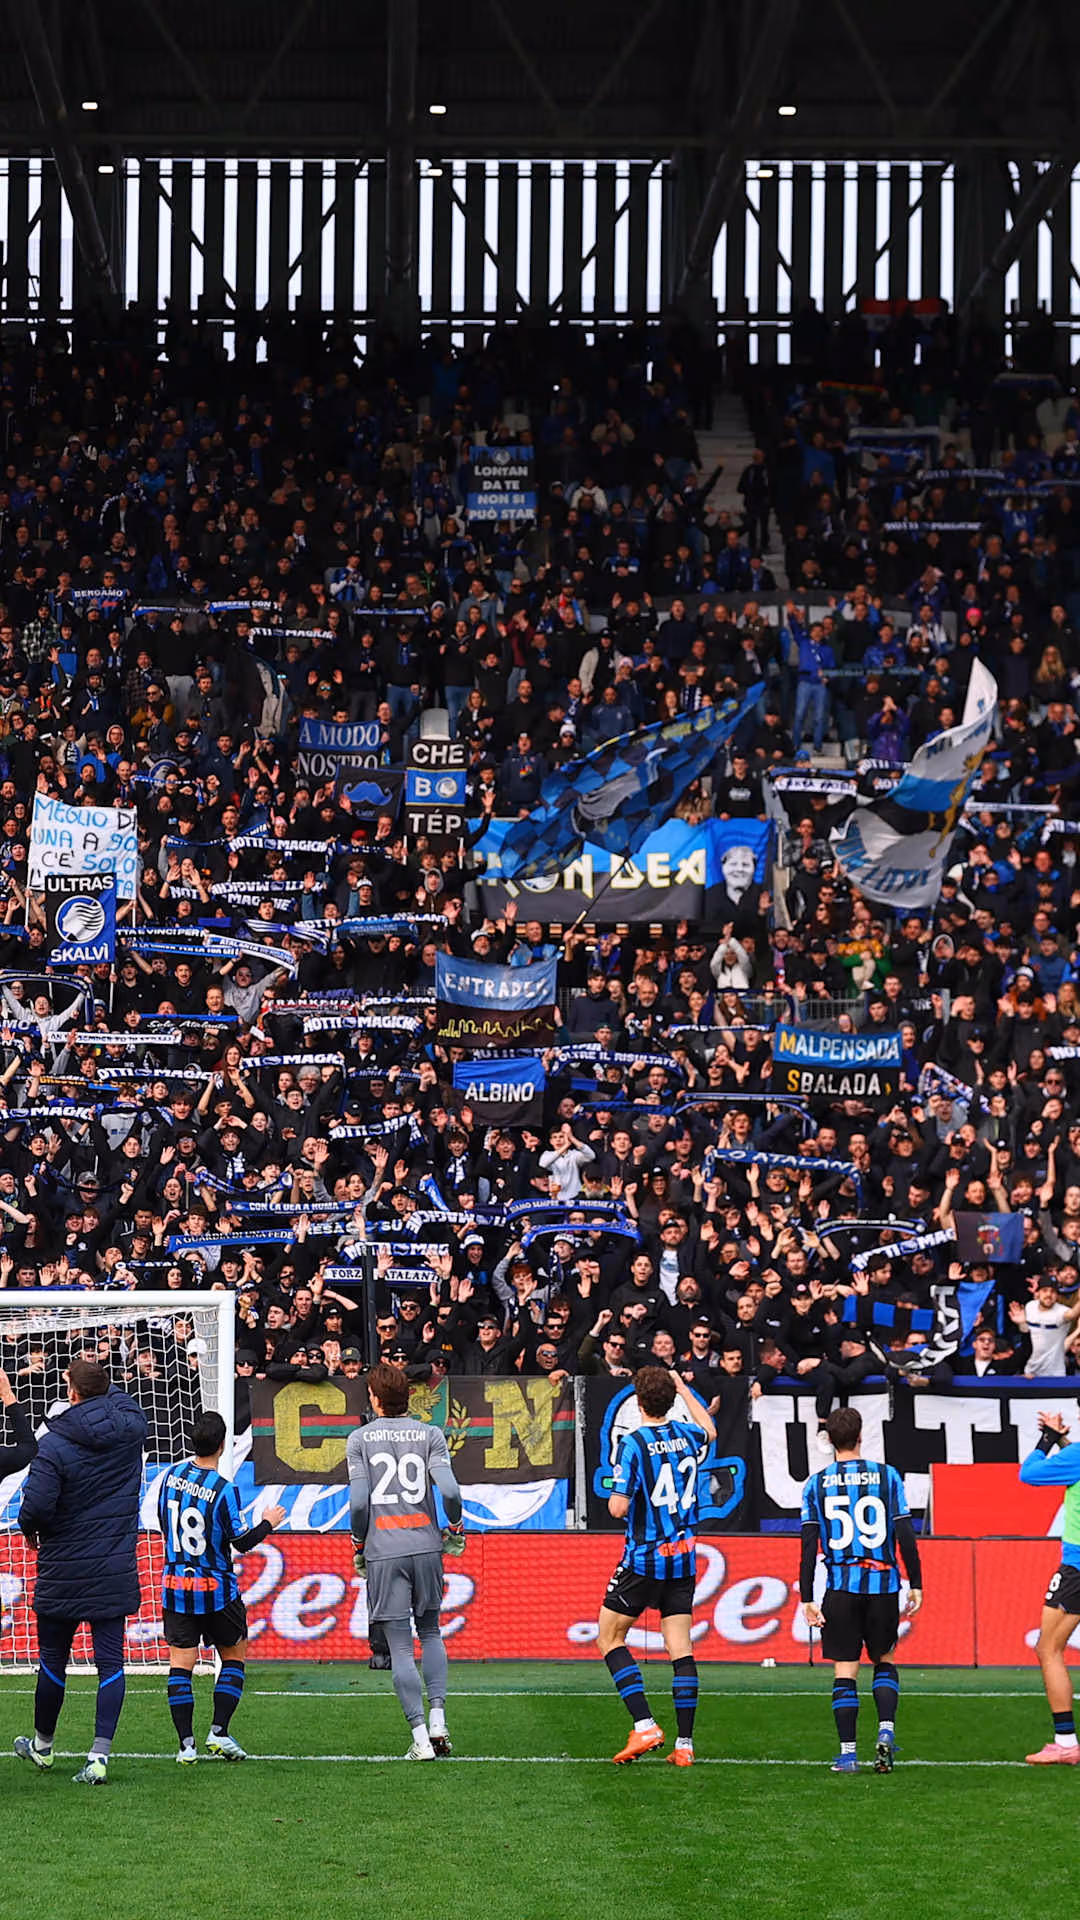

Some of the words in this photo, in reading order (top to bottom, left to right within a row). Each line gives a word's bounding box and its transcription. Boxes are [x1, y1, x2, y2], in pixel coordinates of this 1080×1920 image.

[474, 465, 529, 477] LONTAN
[482, 480, 502, 491] DA
[504, 480, 521, 491] TE
[477, 494, 509, 505] NON
[512, 495, 526, 505] SI
[468, 507, 498, 520] PUÒ
[501, 509, 535, 520] STAR
[74, 590, 124, 598] BERGAMO
[299, 721, 313, 744] A
[318, 722, 380, 748] MODO
[412, 743, 465, 764] CHE
[34, 798, 108, 829] MEGLIO
[117, 810, 137, 831] DI
[408, 808, 462, 834] TÉP
[33, 827, 73, 849] UNA
[83, 832, 99, 851] A
[108, 832, 137, 853] 90
[229, 837, 264, 851] NOTTI
[82, 854, 136, 875] SOLO
[47, 874, 115, 893] ULTRAS
[50, 942, 110, 963] SKALVÌ
[179, 1020, 229, 1031] Atalanta
[303, 1017, 343, 1034] NOTTI
[778, 1030, 900, 1061] MALPENSADA
[283, 1053, 344, 1066] MAGIC
[559, 1050, 597, 1062] OLTRE
[599, 1051, 611, 1060] IL
[614, 1053, 678, 1068] RISULTATO
[97, 1068, 134, 1081] OTTI
[786, 1068, 882, 1096] SBALADA
[464, 1081, 535, 1103] ALBINO
[330, 1125, 368, 1140] OTTI
[248, 1202, 269, 1211] CON
[331, 1269, 362, 1279] FORZ
[273, 1380, 348, 1473] C
[485, 1377, 563, 1470] N
[369, 1452, 427, 1505] 29
[650, 1456, 698, 1514] 42
[821, 1471, 882, 1488] ZALEWSKI
[166, 1474, 218, 1504] RASPADORI
[166, 1499, 207, 1557] 18
[823, 1495, 888, 1550] 59
